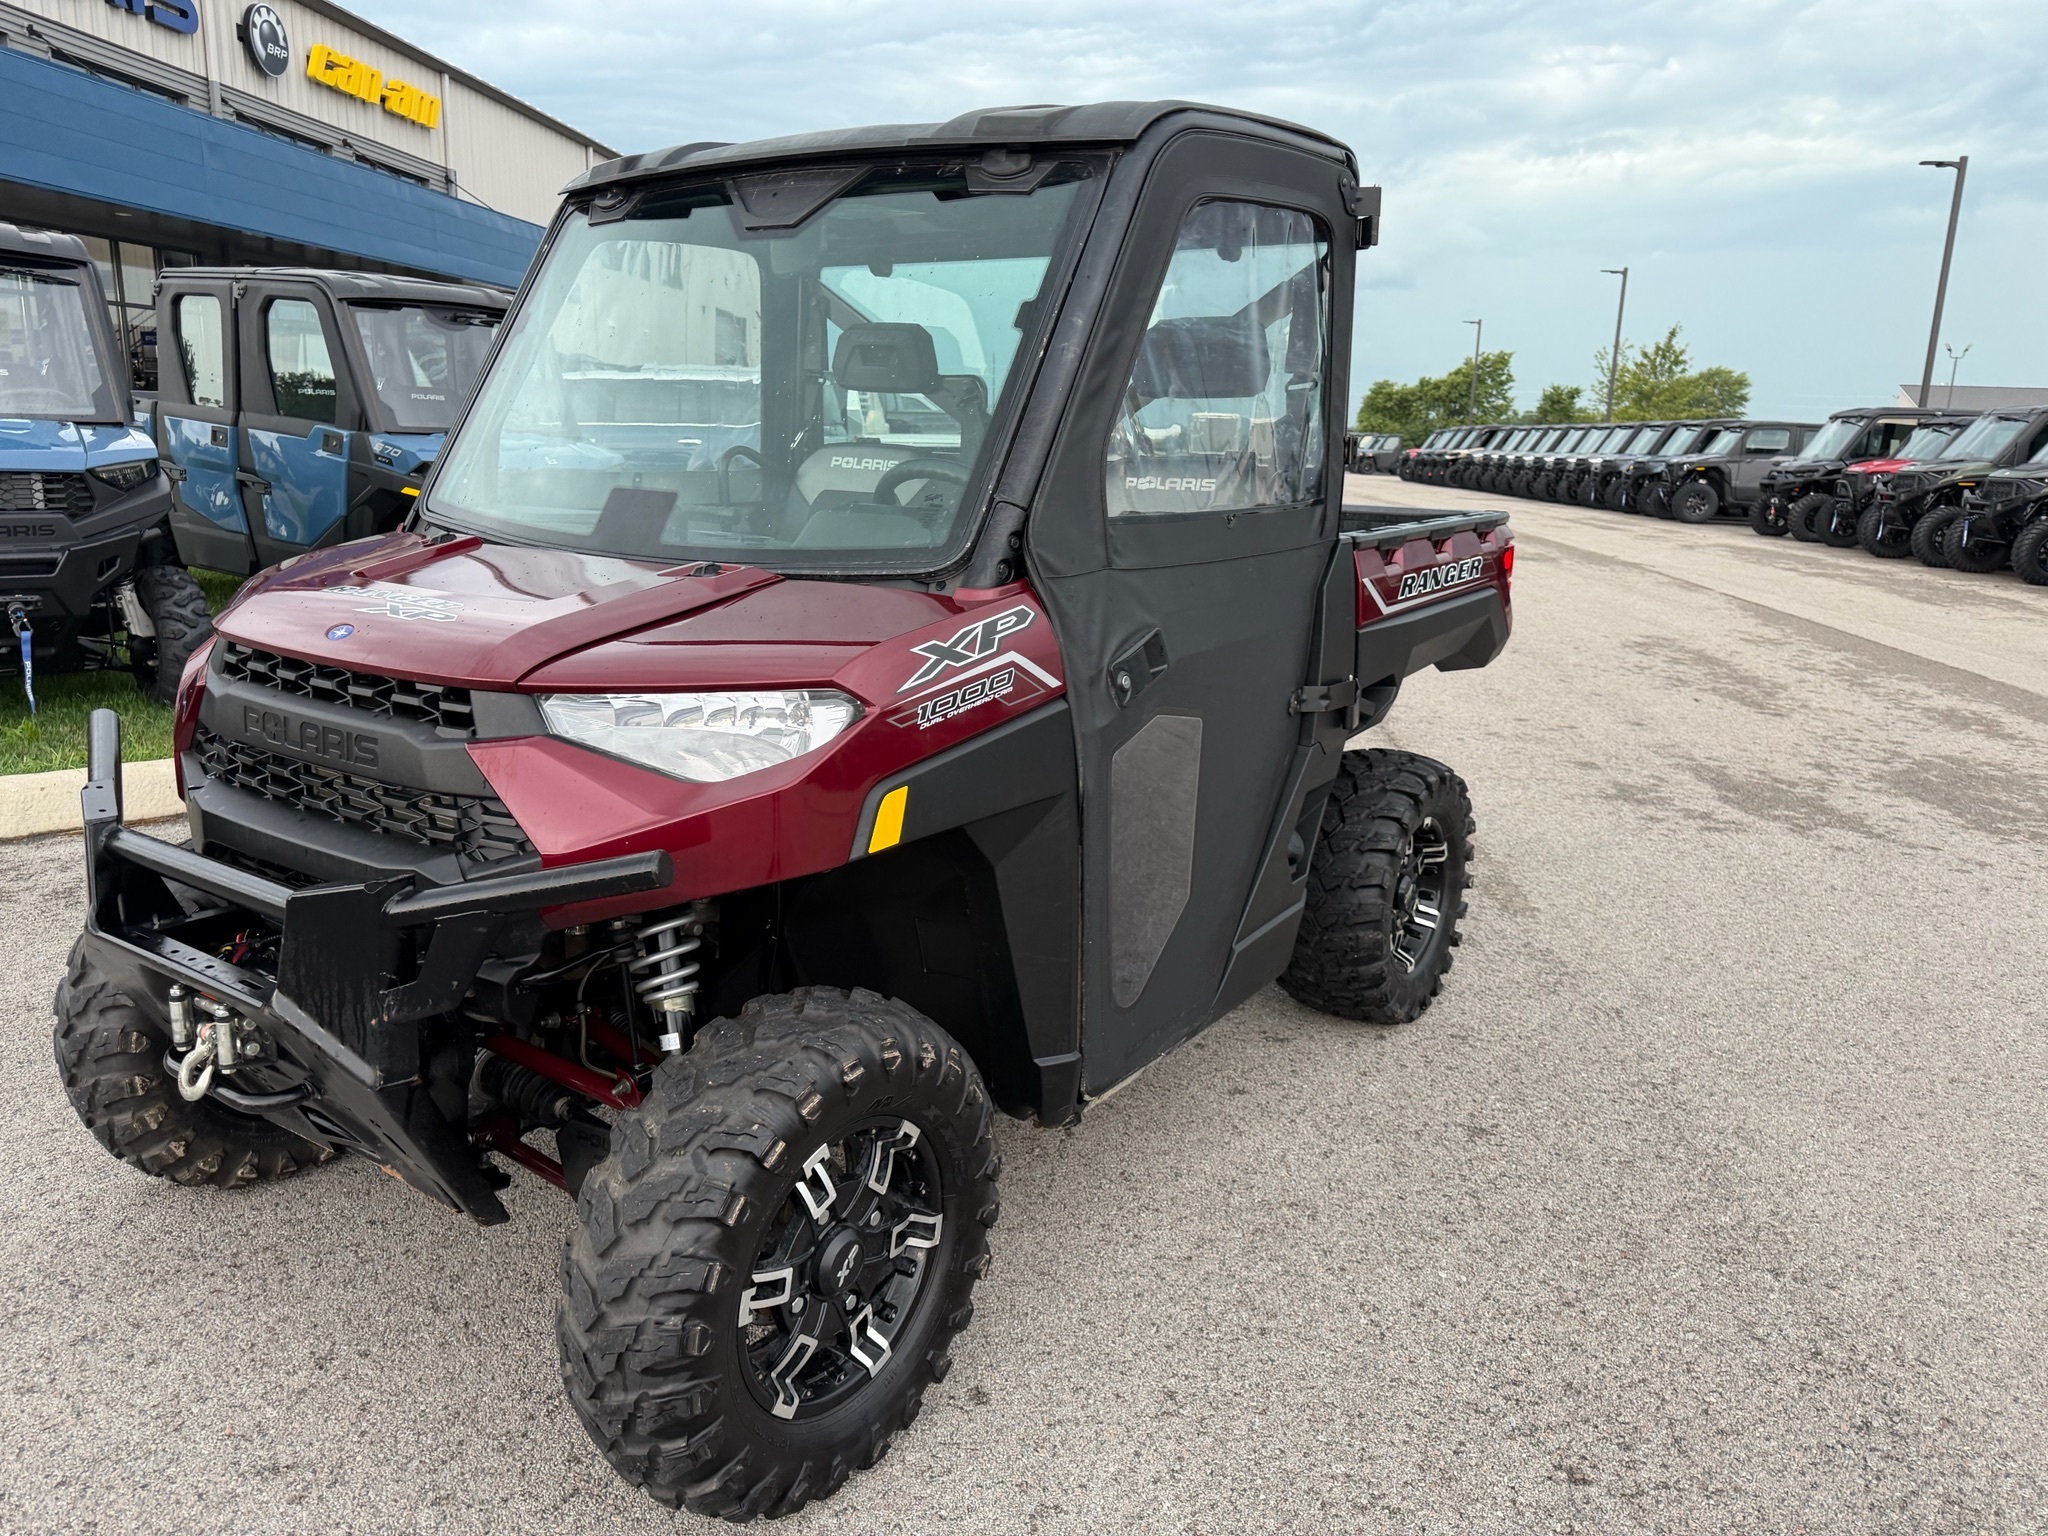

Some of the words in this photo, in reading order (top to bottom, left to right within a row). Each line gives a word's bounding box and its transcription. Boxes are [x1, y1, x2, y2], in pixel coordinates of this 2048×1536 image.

[267, 42, 288, 60] BRP
[298, 388, 336, 396] POLARIS
[411, 393, 446, 401] POLARIS
[1125, 476, 1217, 492] POLARIS
[1398, 556, 1484, 600] RANGER
[352, 601, 459, 622] XP
[896, 605, 1036, 693] XP
[917, 667, 1015, 725] 1000
[920, 717, 945, 730] DUAL
[947, 694, 994, 718] OVERHEAD
[994, 687, 1014, 699] CAM
[244, 705, 379, 770] POLARIS
